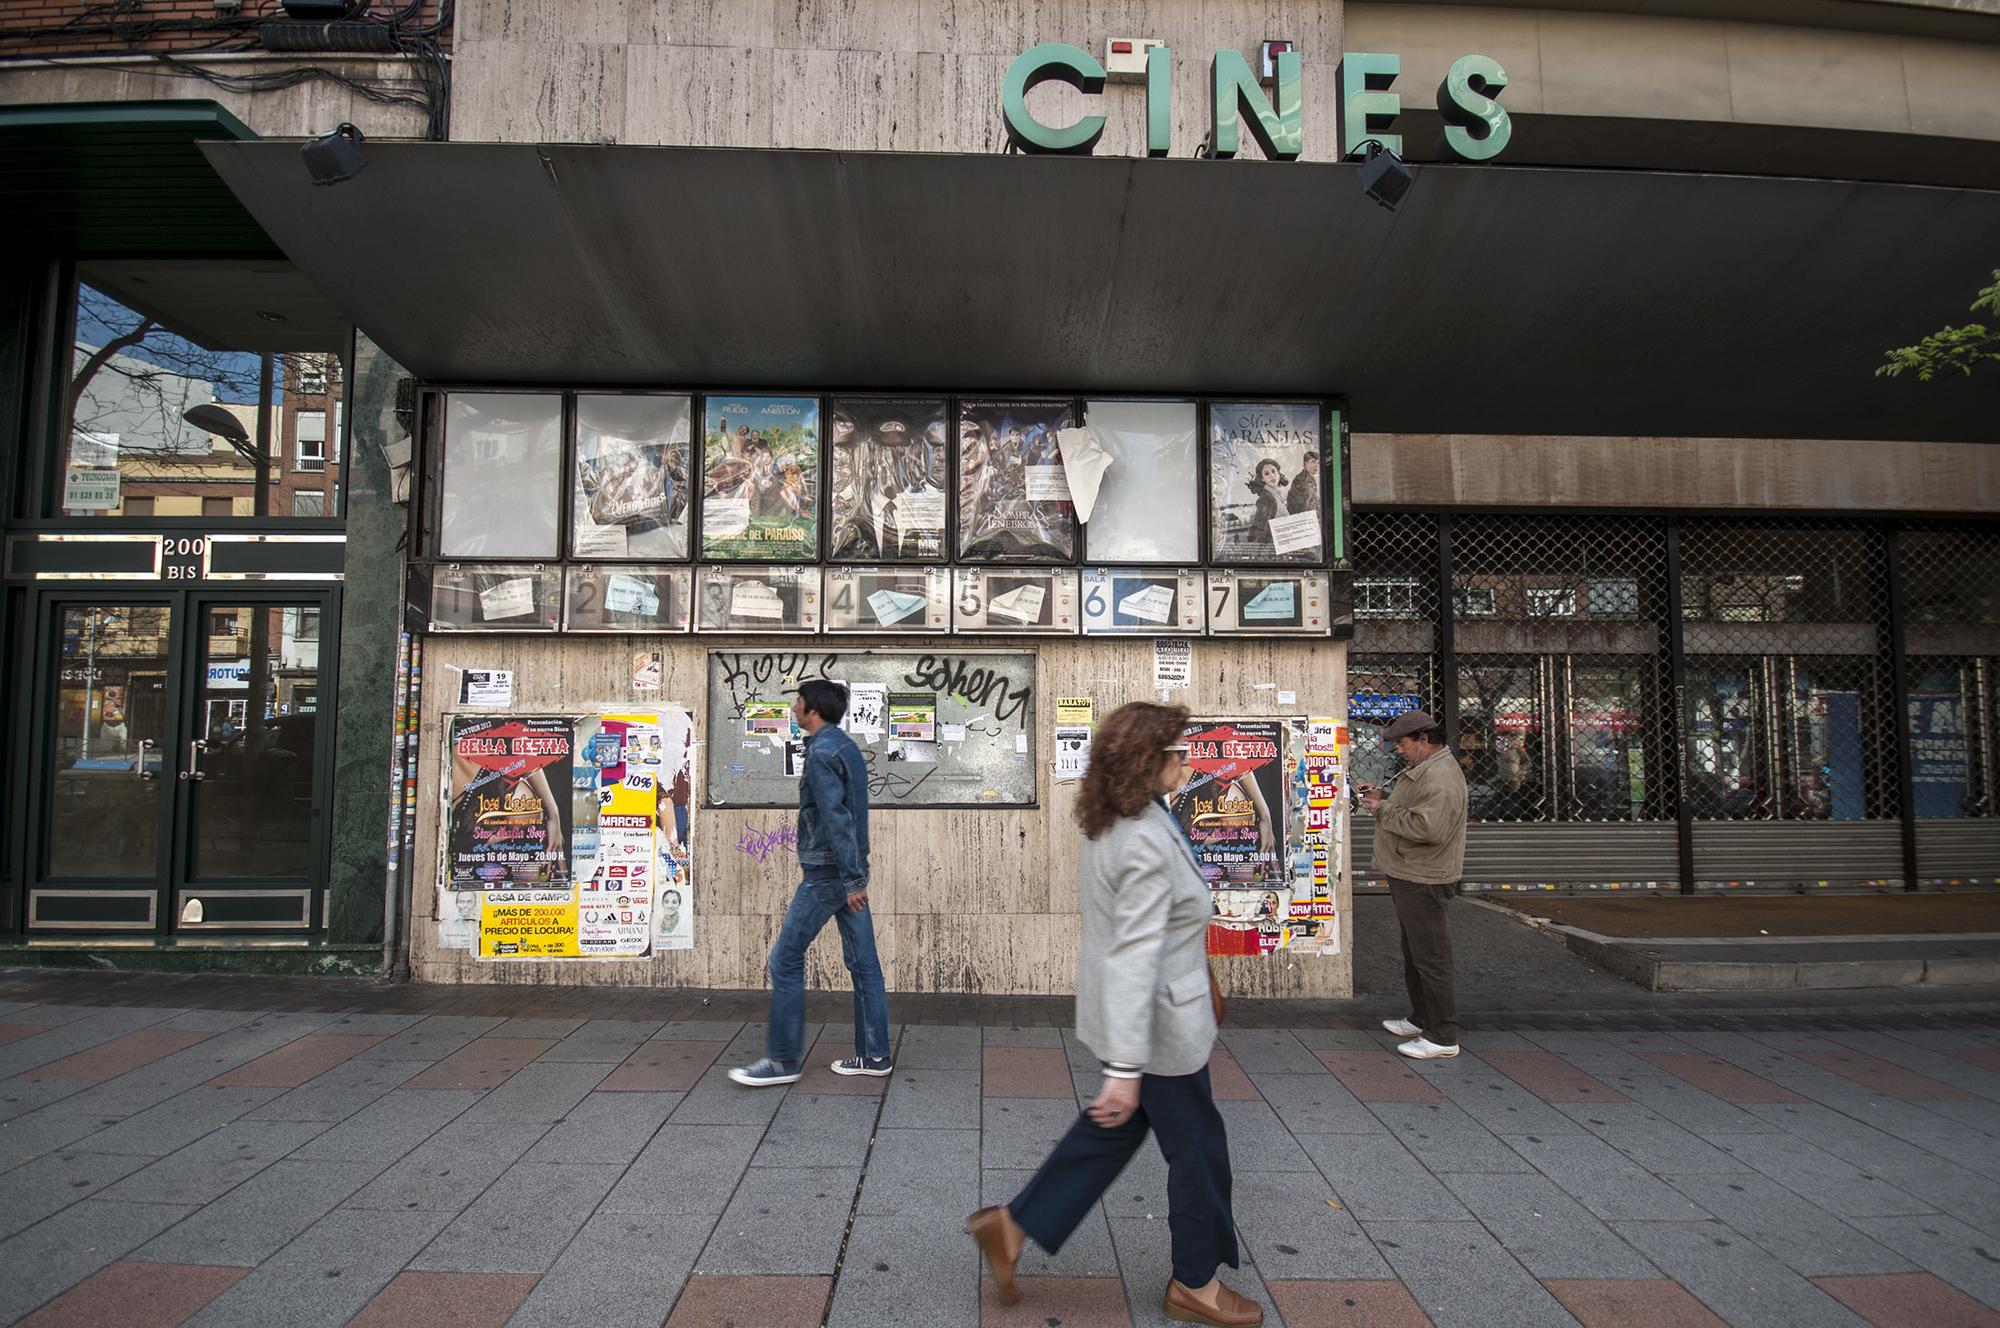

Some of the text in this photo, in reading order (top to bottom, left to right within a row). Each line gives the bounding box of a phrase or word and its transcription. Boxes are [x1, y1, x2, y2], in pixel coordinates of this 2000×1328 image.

[1002, 42, 1512, 161] CINES
[760, 407, 801, 415] ANISTON
[1220, 428, 1313, 444] NARANJAS
[749, 530, 763, 540] DEL
[164, 538, 204, 555] 200
[167, 566, 197, 579] BIS
[576, 581, 597, 614] 2
[831, 583, 854, 615] 4
[960, 585, 981, 616] 5
[1084, 585, 1106, 617] 6
[1212, 586, 1231, 618] 7
[457, 738, 570, 756] BELLA BESTIA
[1187, 741, 1278, 757] LLA BESTIA
[626, 775, 652, 788] 10%
[601, 816, 647, 827] MARCAS
[526, 825, 546, 843] Boy
[1240, 827, 1259, 844] Boy
[458, 852, 485, 862] Jueves
[487, 852, 495, 861] 16
[497, 852, 506, 861] de
[508, 852, 529, 863] Mayo
[535, 851, 557, 861] 20:00
[558, 851, 566, 861] H.
[1203, 853, 1212, 862] 16
[1213, 853, 1222, 862] de
[1223, 852, 1243, 863] Mayo
[488, 893, 515, 902] CASA
[517, 893, 531, 901] DE
[534, 893, 570, 902] CAMPO
[534, 908, 565, 916] 200.000
[485, 926, 574, 935] PRECIO DE LOCURA!
